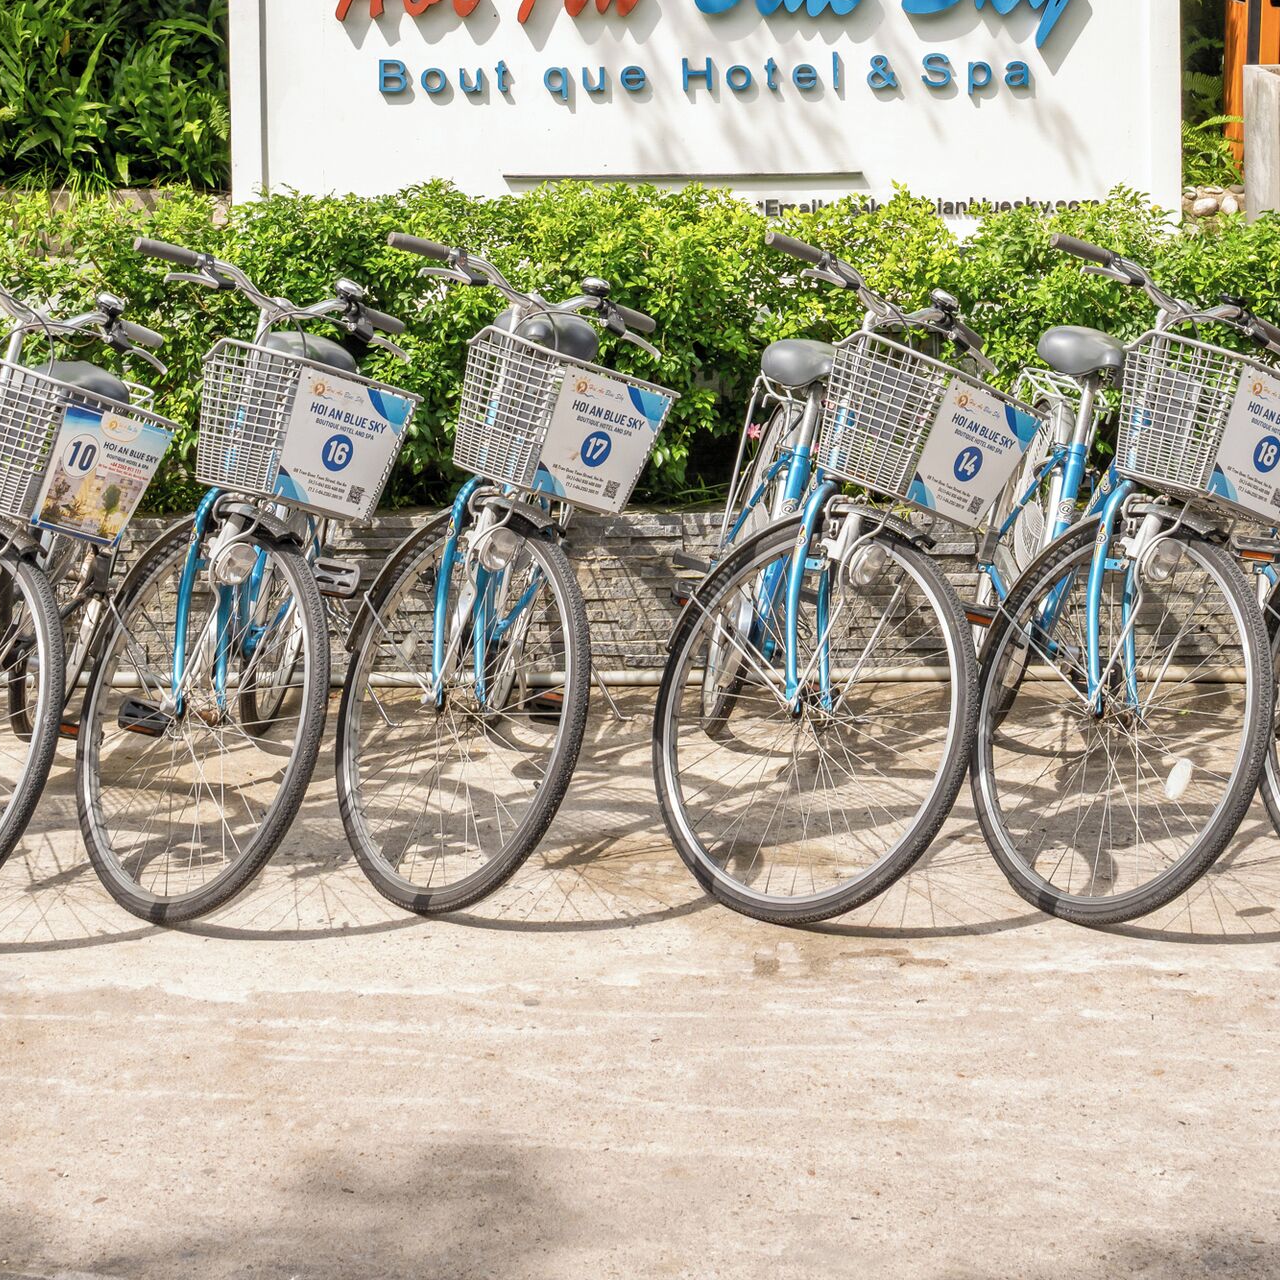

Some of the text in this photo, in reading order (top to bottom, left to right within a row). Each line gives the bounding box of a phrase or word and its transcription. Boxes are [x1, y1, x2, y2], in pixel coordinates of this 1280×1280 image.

[682, 51, 839, 92] Hotel
[866, 54, 898, 89] &
[921, 53, 1030, 96] Spa
[309, 401, 387, 434] HOI AN BLUE SKY
[571, 399, 644, 431] HOI AN BLUE SKY
[1247, 400, 1263, 416] HOI
[1262, 407, 1276, 422] AN
[1250, 417, 1271, 430] BOUTIQUE
[315, 417, 339, 429] BOUTIQUE
[339, 425, 354, 434] HOTEL
[354, 429, 365, 437] AND
[576, 415, 599, 426] BOUTIQUE
[598, 422, 613, 430] HOTEL
[613, 426, 623, 434] AND
[951, 412, 1015, 450] HOI AN BLUE SKY
[102, 441, 159, 464] HOI AN BLUE SKY
[327, 440, 349, 465] 16
[585, 437, 608, 460] 17
[954, 428, 1003, 455] BOUTIQUE HOTEL AND SPA
[1257, 441, 1277, 467] 18
[68, 440, 97, 471] 10
[958, 452, 978, 476] 14
